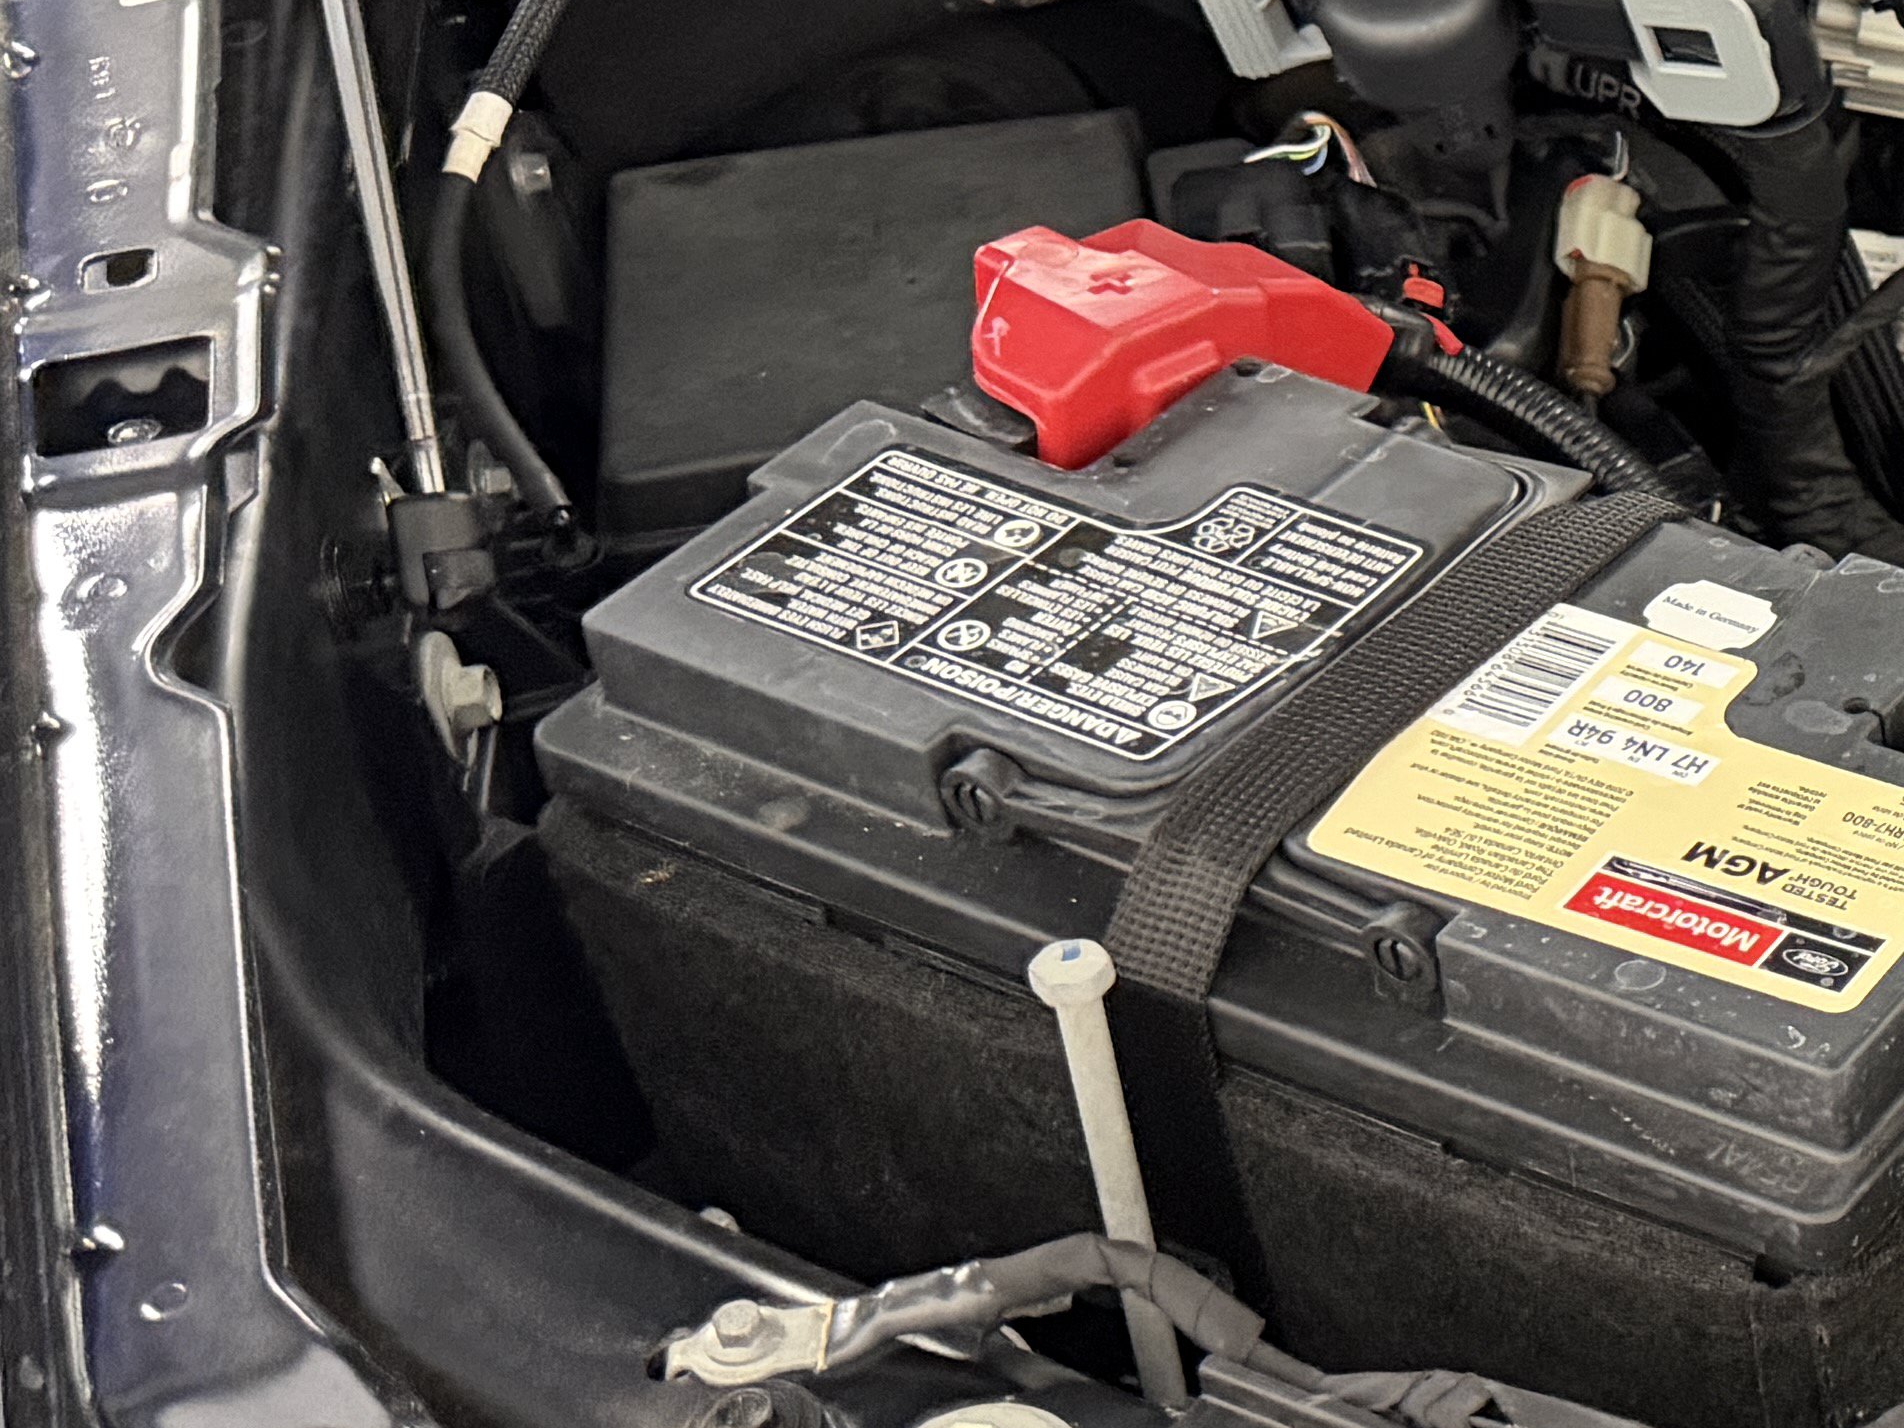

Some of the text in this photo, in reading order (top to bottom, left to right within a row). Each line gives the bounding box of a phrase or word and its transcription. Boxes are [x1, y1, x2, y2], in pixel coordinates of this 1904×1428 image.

[1576, 64, 1641, 119] UPR
[1662, 595, 1760, 634] Made in Germany
[1661, 653, 1707, 676] 140
[915, 656, 1126, 738] DANGER/POISON
[1620, 687, 1674, 713] 800
[1564, 718, 1619, 745] 94R
[1617, 735, 1671, 762] LN4
[1669, 751, 1710, 774] H7
[1382, 839, 1424, 856] Canada
[1433, 854, 1485, 875] Company
[1467, 854, 1509, 872] Canada
[1679, 839, 1791, 889] AGM
[1481, 870, 1516, 885] Motor
[1512, 880, 1540, 893] Ford
[1521, 871, 1549, 884] Ford
[1779, 880, 1852, 910] TESTED
[1586, 883, 1763, 954] Motorcraft
